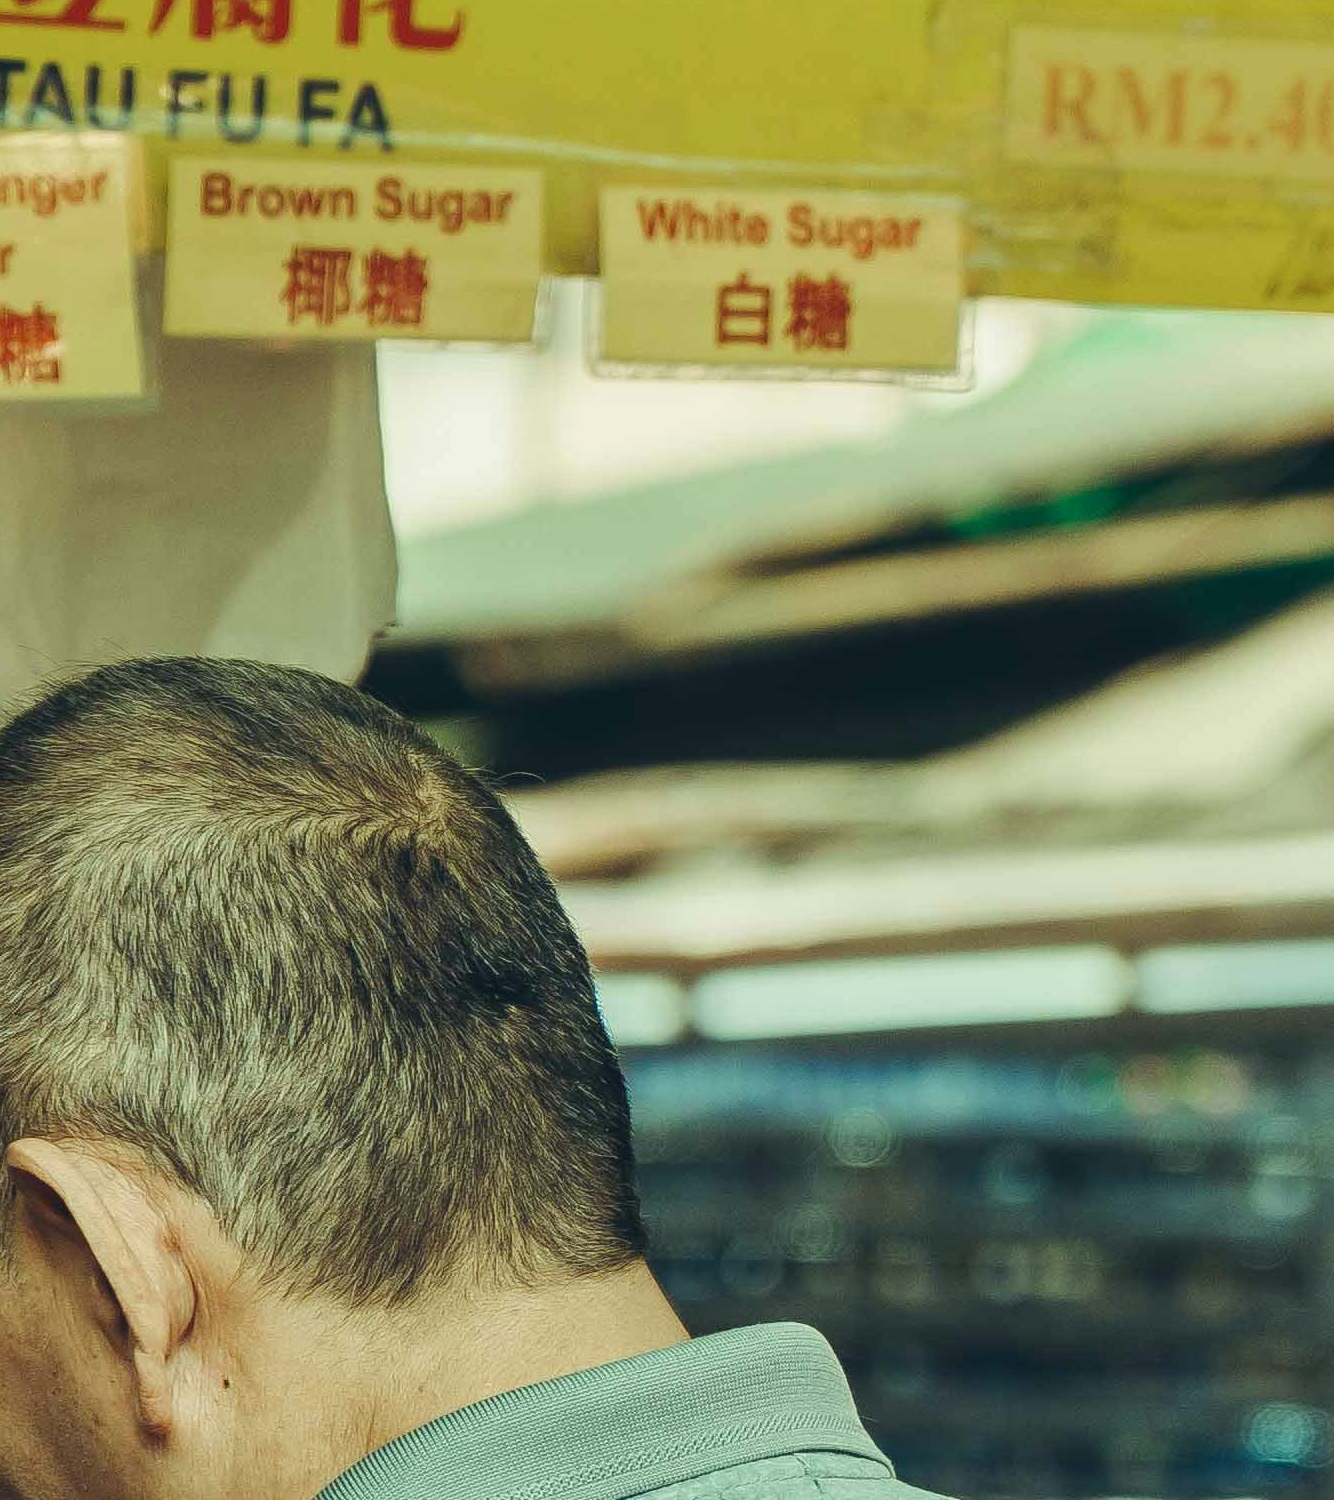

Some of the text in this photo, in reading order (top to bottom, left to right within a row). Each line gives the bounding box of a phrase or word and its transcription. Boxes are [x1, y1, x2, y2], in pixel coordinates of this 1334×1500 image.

[164, 69, 267, 144] FU
[297, 77, 395, 153] FA
[199, 172, 517, 234] Brown Sugar
[636, 198, 923, 260] White Sugar
[714, 270, 855, 353] 白糖
